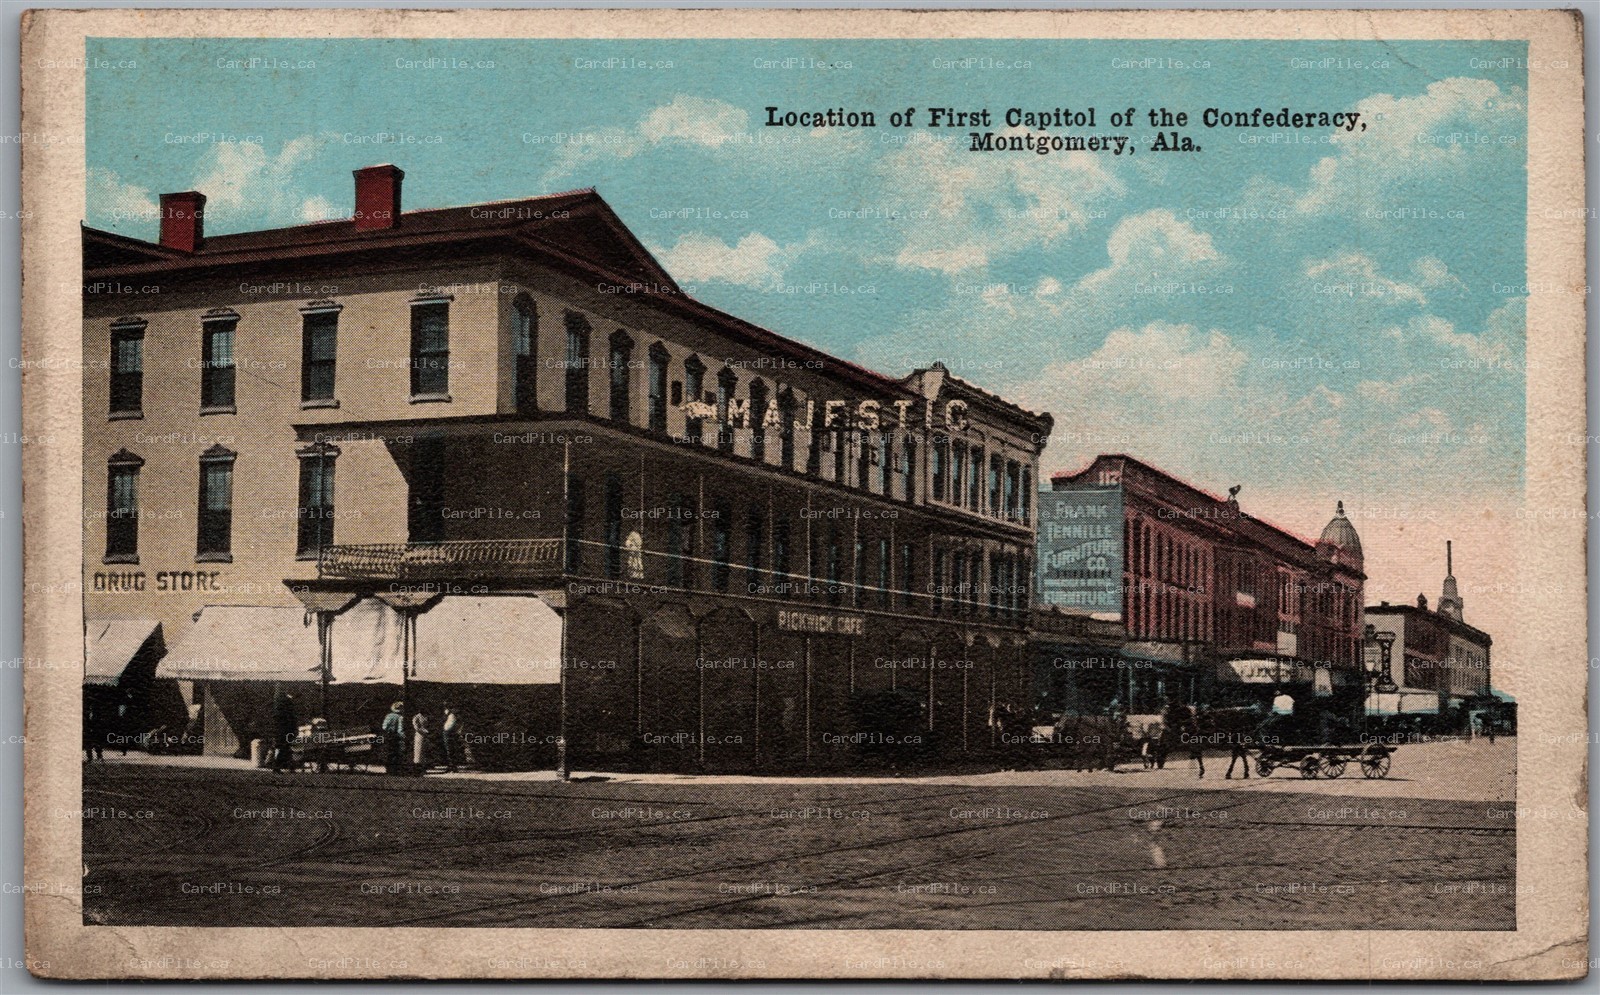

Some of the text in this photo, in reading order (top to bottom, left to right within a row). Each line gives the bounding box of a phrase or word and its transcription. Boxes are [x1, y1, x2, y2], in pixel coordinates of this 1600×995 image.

[727, 399, 968, 431] MAJESTIC
[1056, 502, 1108, 518] FRANK
[1046, 521, 1113, 542] TENNILLE
[1044, 539, 1118, 574] FURNITURE
[94, 571, 220, 591] DRUG STORE
